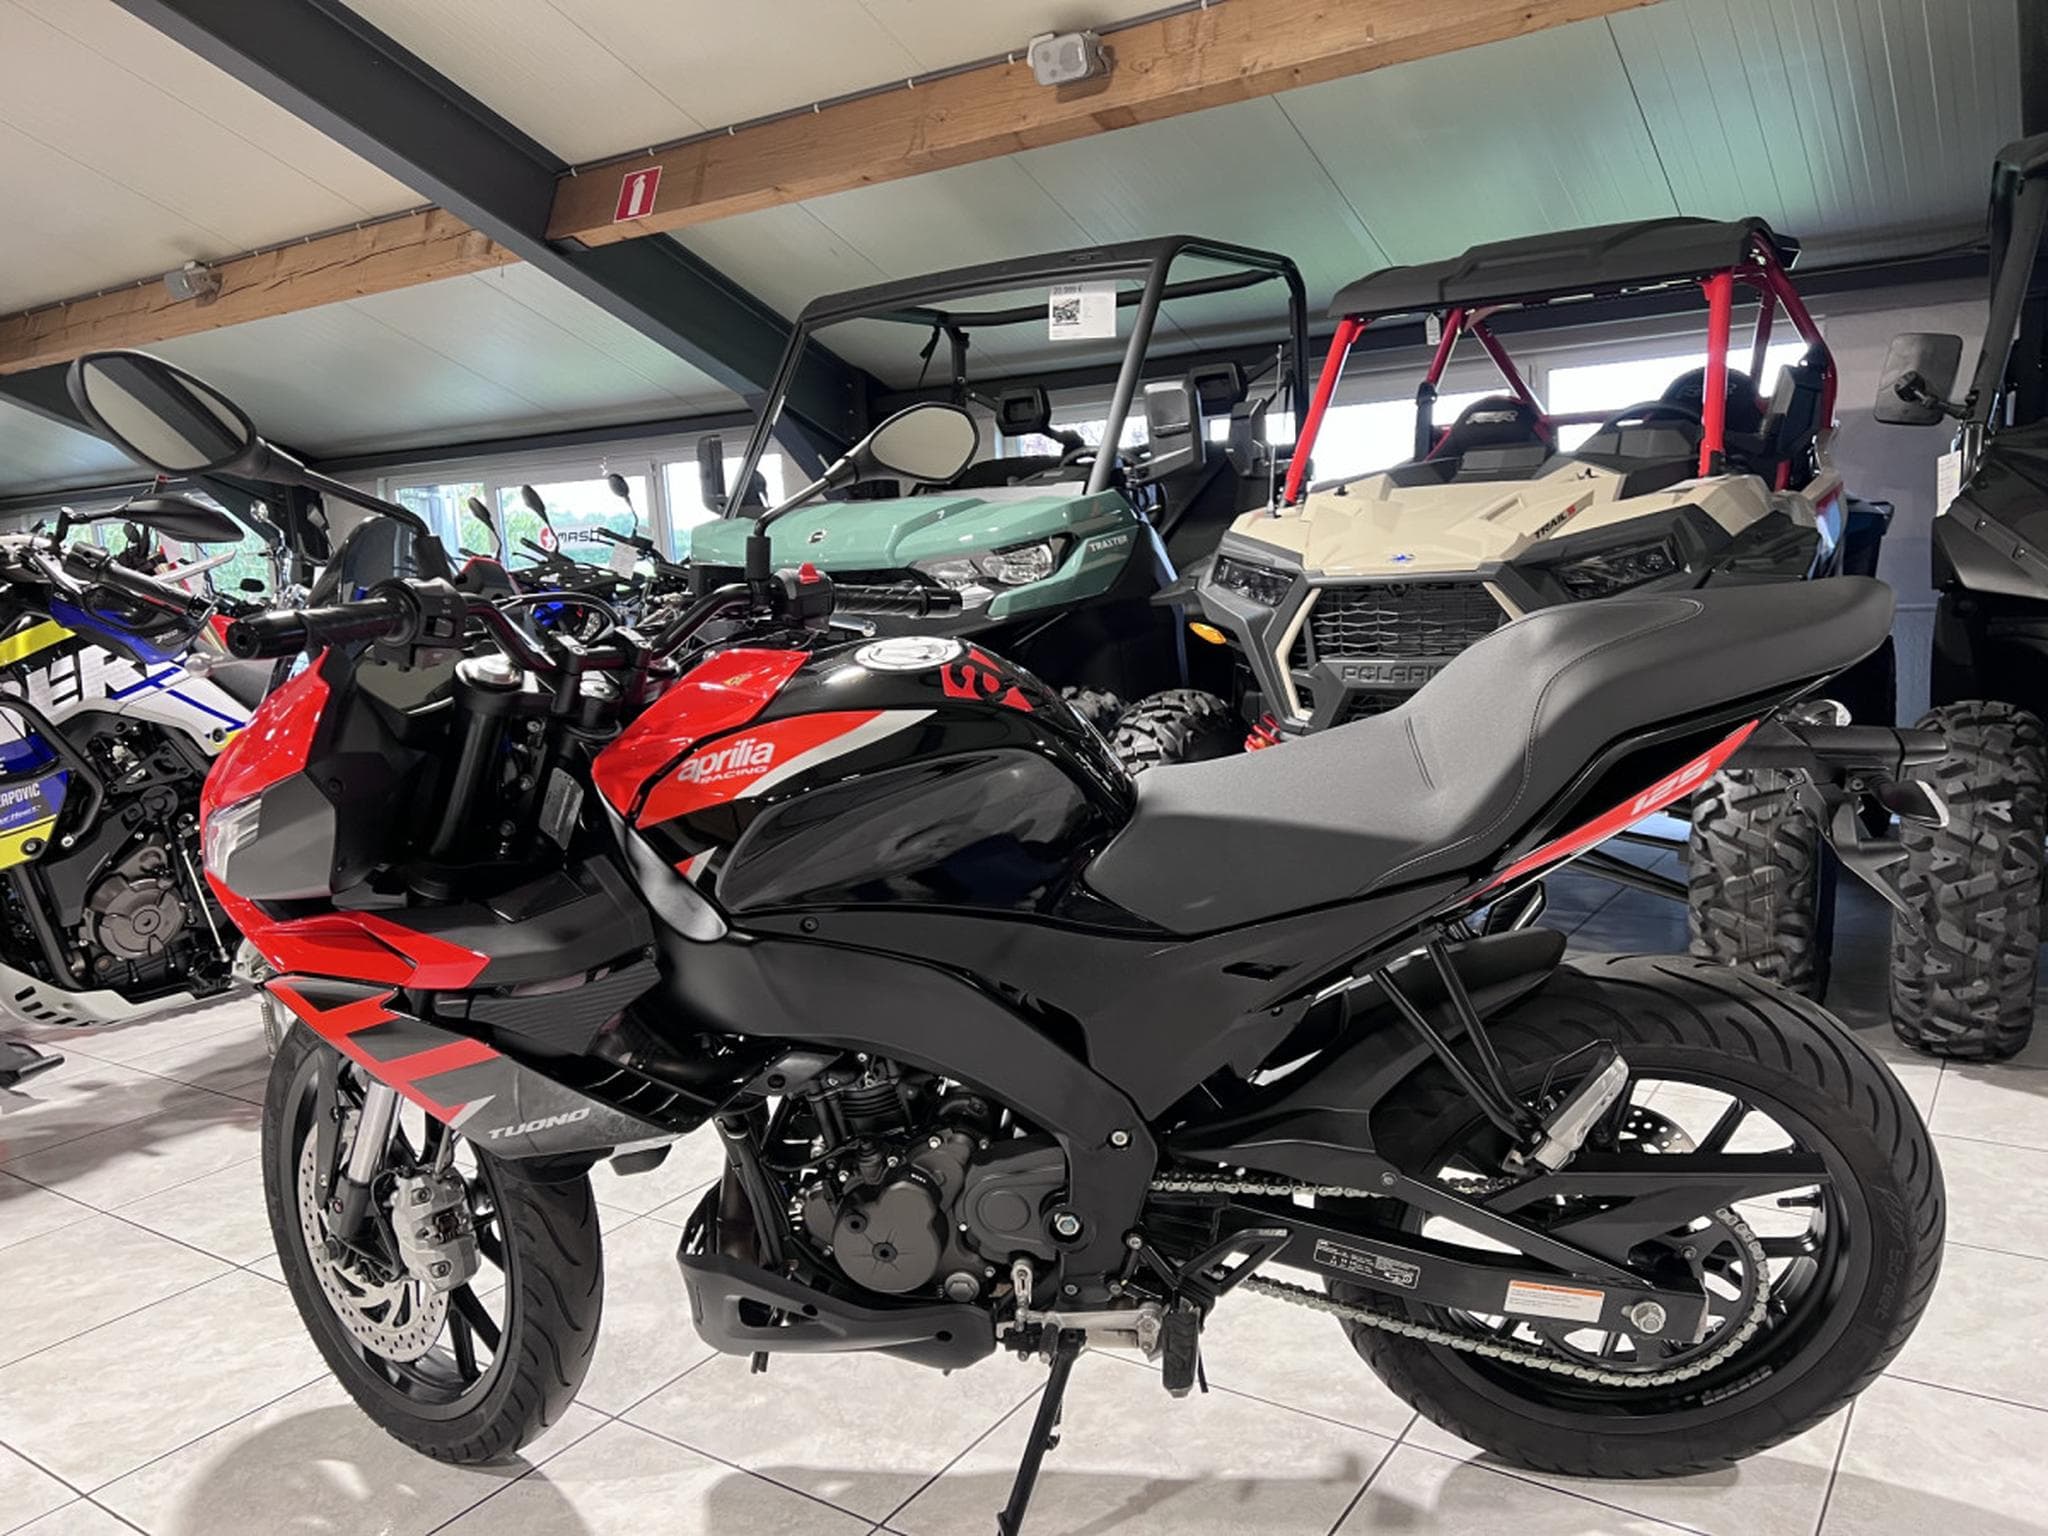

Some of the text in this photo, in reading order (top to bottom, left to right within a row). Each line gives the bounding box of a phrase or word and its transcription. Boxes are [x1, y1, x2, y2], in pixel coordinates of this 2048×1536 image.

[1341, 664, 1445, 682] POLARI
[677, 738, 775, 784] aprilia
[700, 765, 768, 784] RACING
[488, 1107, 591, 1139] TUONO
